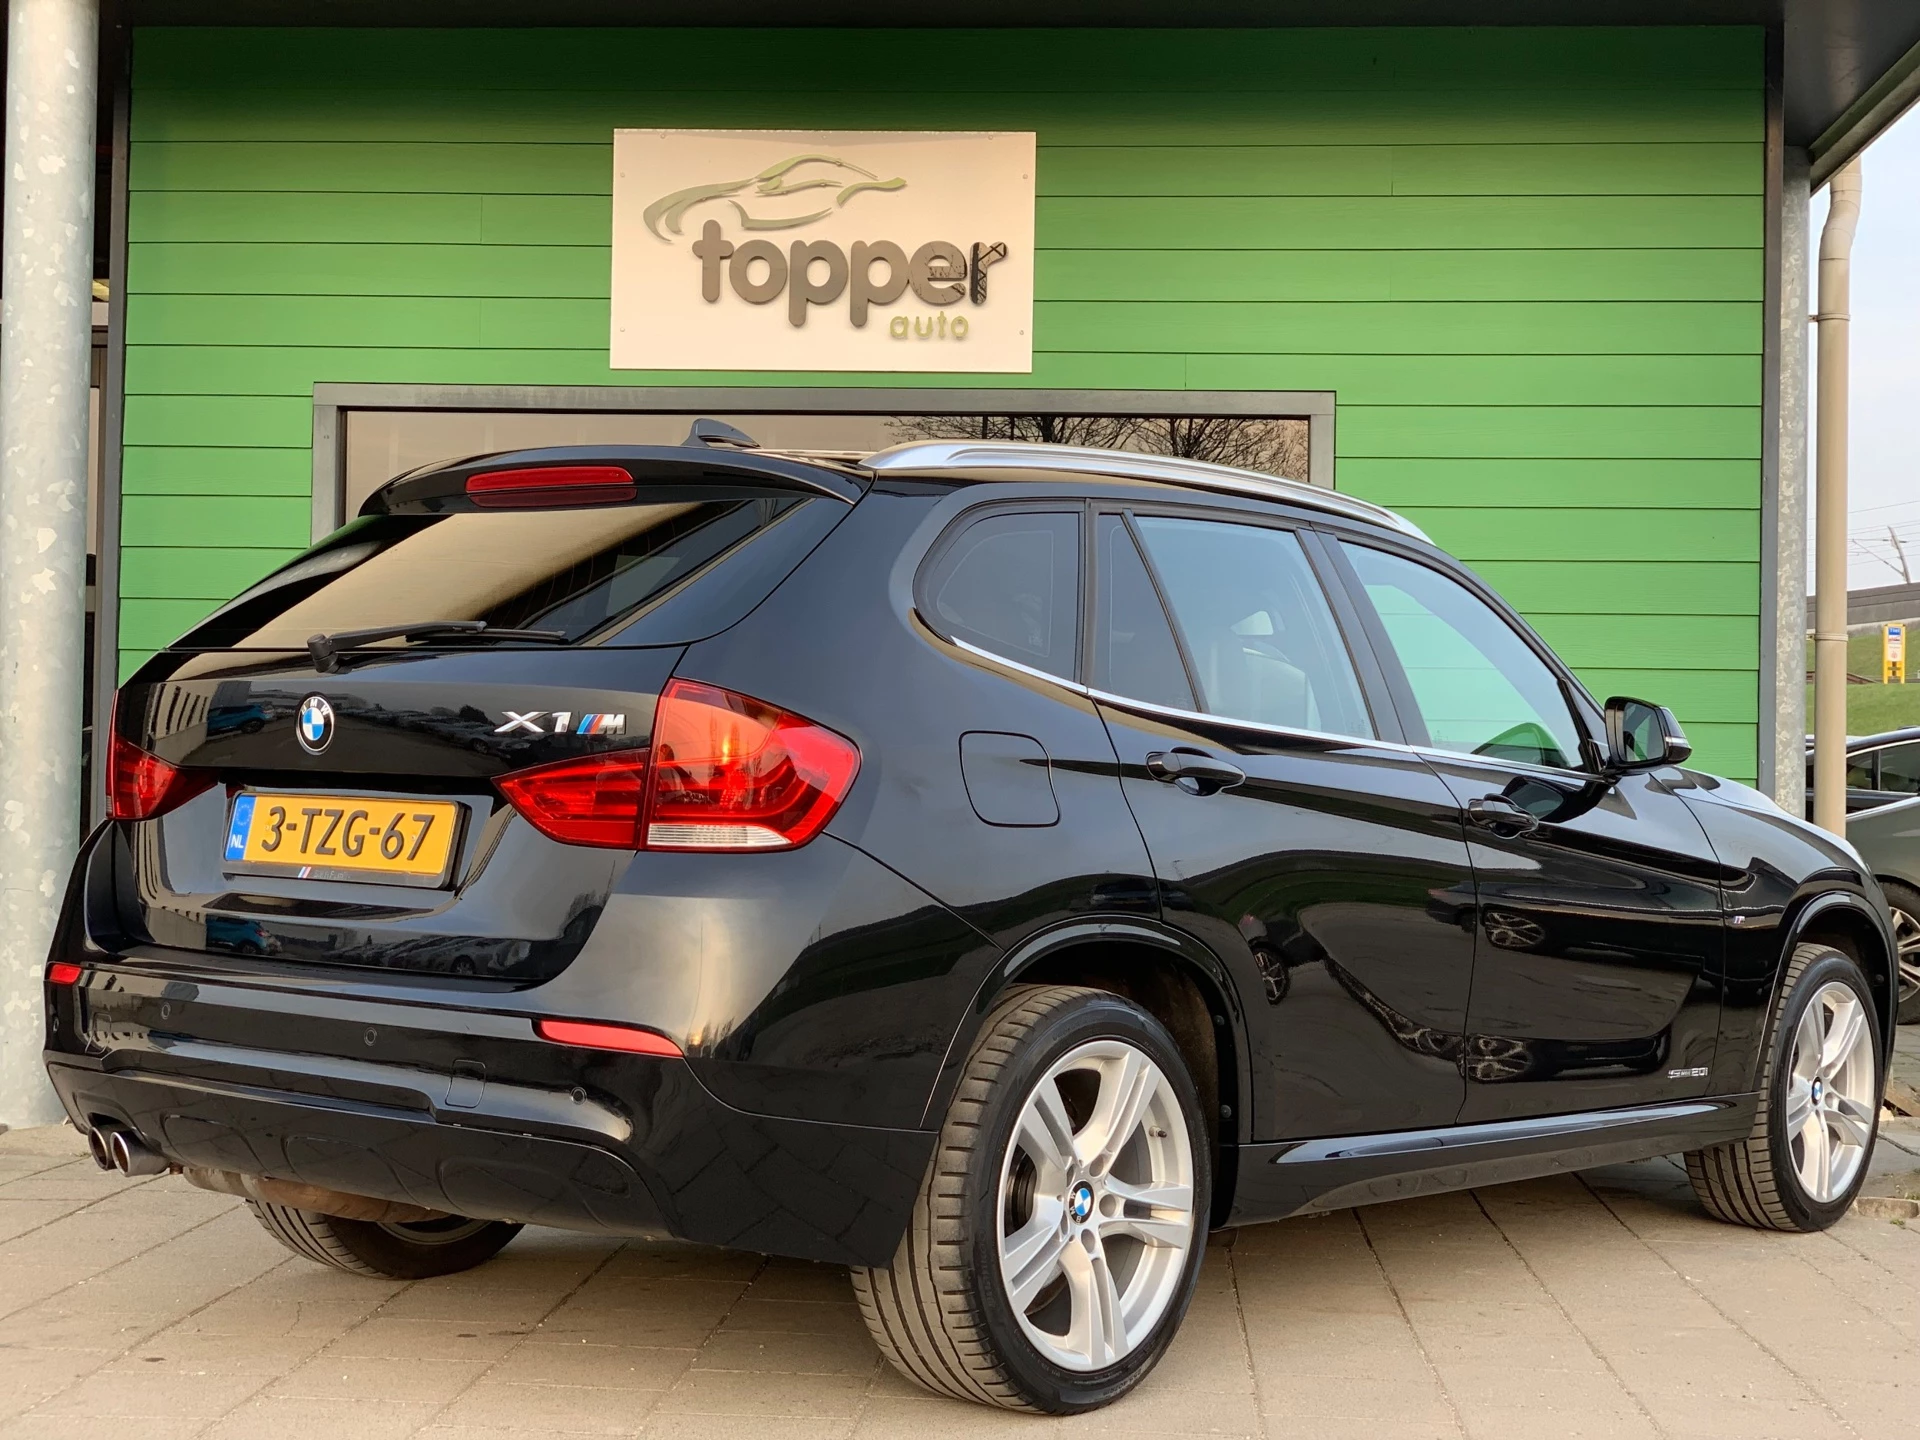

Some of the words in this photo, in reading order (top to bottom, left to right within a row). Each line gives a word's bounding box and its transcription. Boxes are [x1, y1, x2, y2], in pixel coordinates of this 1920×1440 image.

[692, 219, 1009, 327] topper
[889, 311, 969, 338] auto
[494, 711, 572, 733] X1
[231, 834, 244, 849] NL
[261, 806, 436, 861] 3-TZG-67
